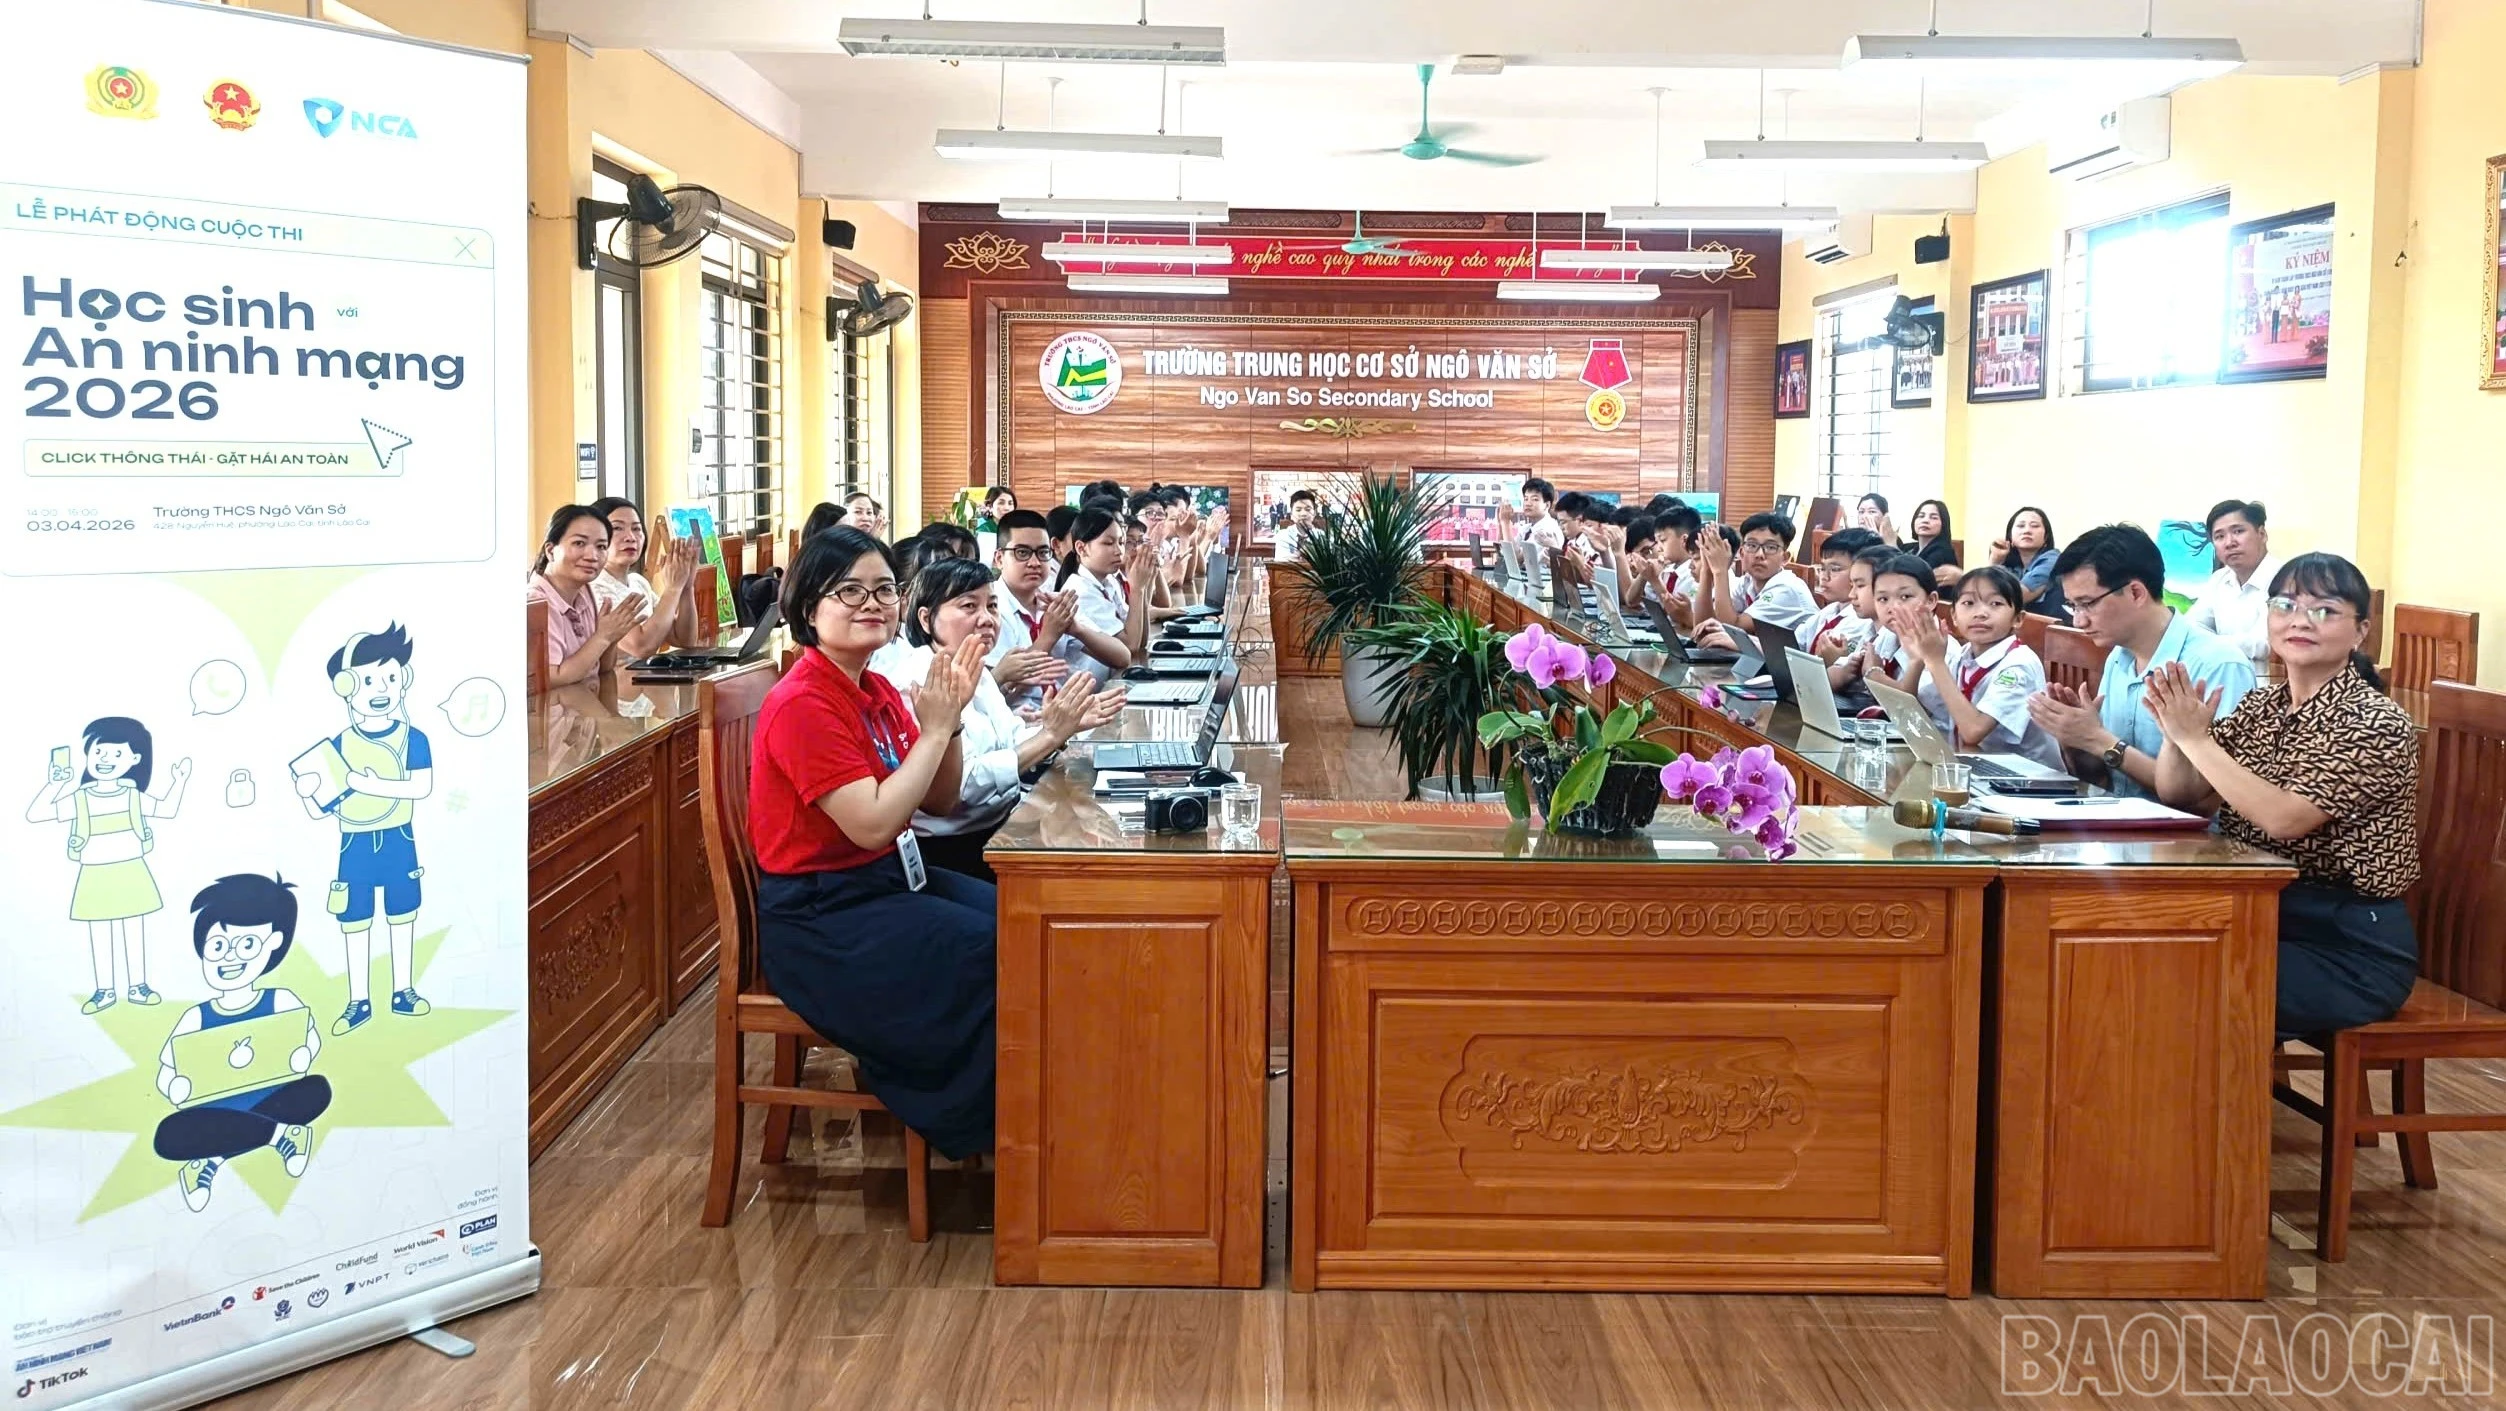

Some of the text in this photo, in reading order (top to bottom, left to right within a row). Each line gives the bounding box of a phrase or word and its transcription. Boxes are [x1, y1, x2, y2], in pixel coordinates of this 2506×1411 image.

[351, 110, 418, 139] NCA
[16, 197, 303, 241] LỄ PHÁT ĐỘNG CUỘC THI
[1242, 241, 1284, 274] nghề
[1288, 253, 1316, 265] cao
[1461, 250, 1488, 268] các
[2302, 248, 2330, 269] NIỆM
[22, 275, 315, 333] Học sinh
[336, 306, 359, 318] với
[22, 326, 466, 391] An ninh mạng
[1143, 344, 1558, 383] TRƯỜNG TRUNG HỌC CƠ SỞ NGÔ VĂN SỞ
[24, 376, 219, 421] 2026
[1200, 387, 1494, 412] Ngo Van So Secondary School
[41, 452, 97, 465] CLICK
[99, 449, 165, 465] THÔNG
[167, 449, 208, 465] THÁI
[216, 451, 248, 467] GẶT
[250, 451, 277, 465] HÁI
[280, 454, 304, 465] AN
[306, 451, 350, 466] TOÀN
[153, 503, 347, 518] Trường THCS Ngô Văn Sở
[27, 520, 136, 532] 03.04.2026
[393, 1241, 415, 1255] World
[359, 1273, 390, 1288] VNPT
[163, 1308, 222, 1332] VietinBank
[39, 1367, 89, 1390] TikTok
